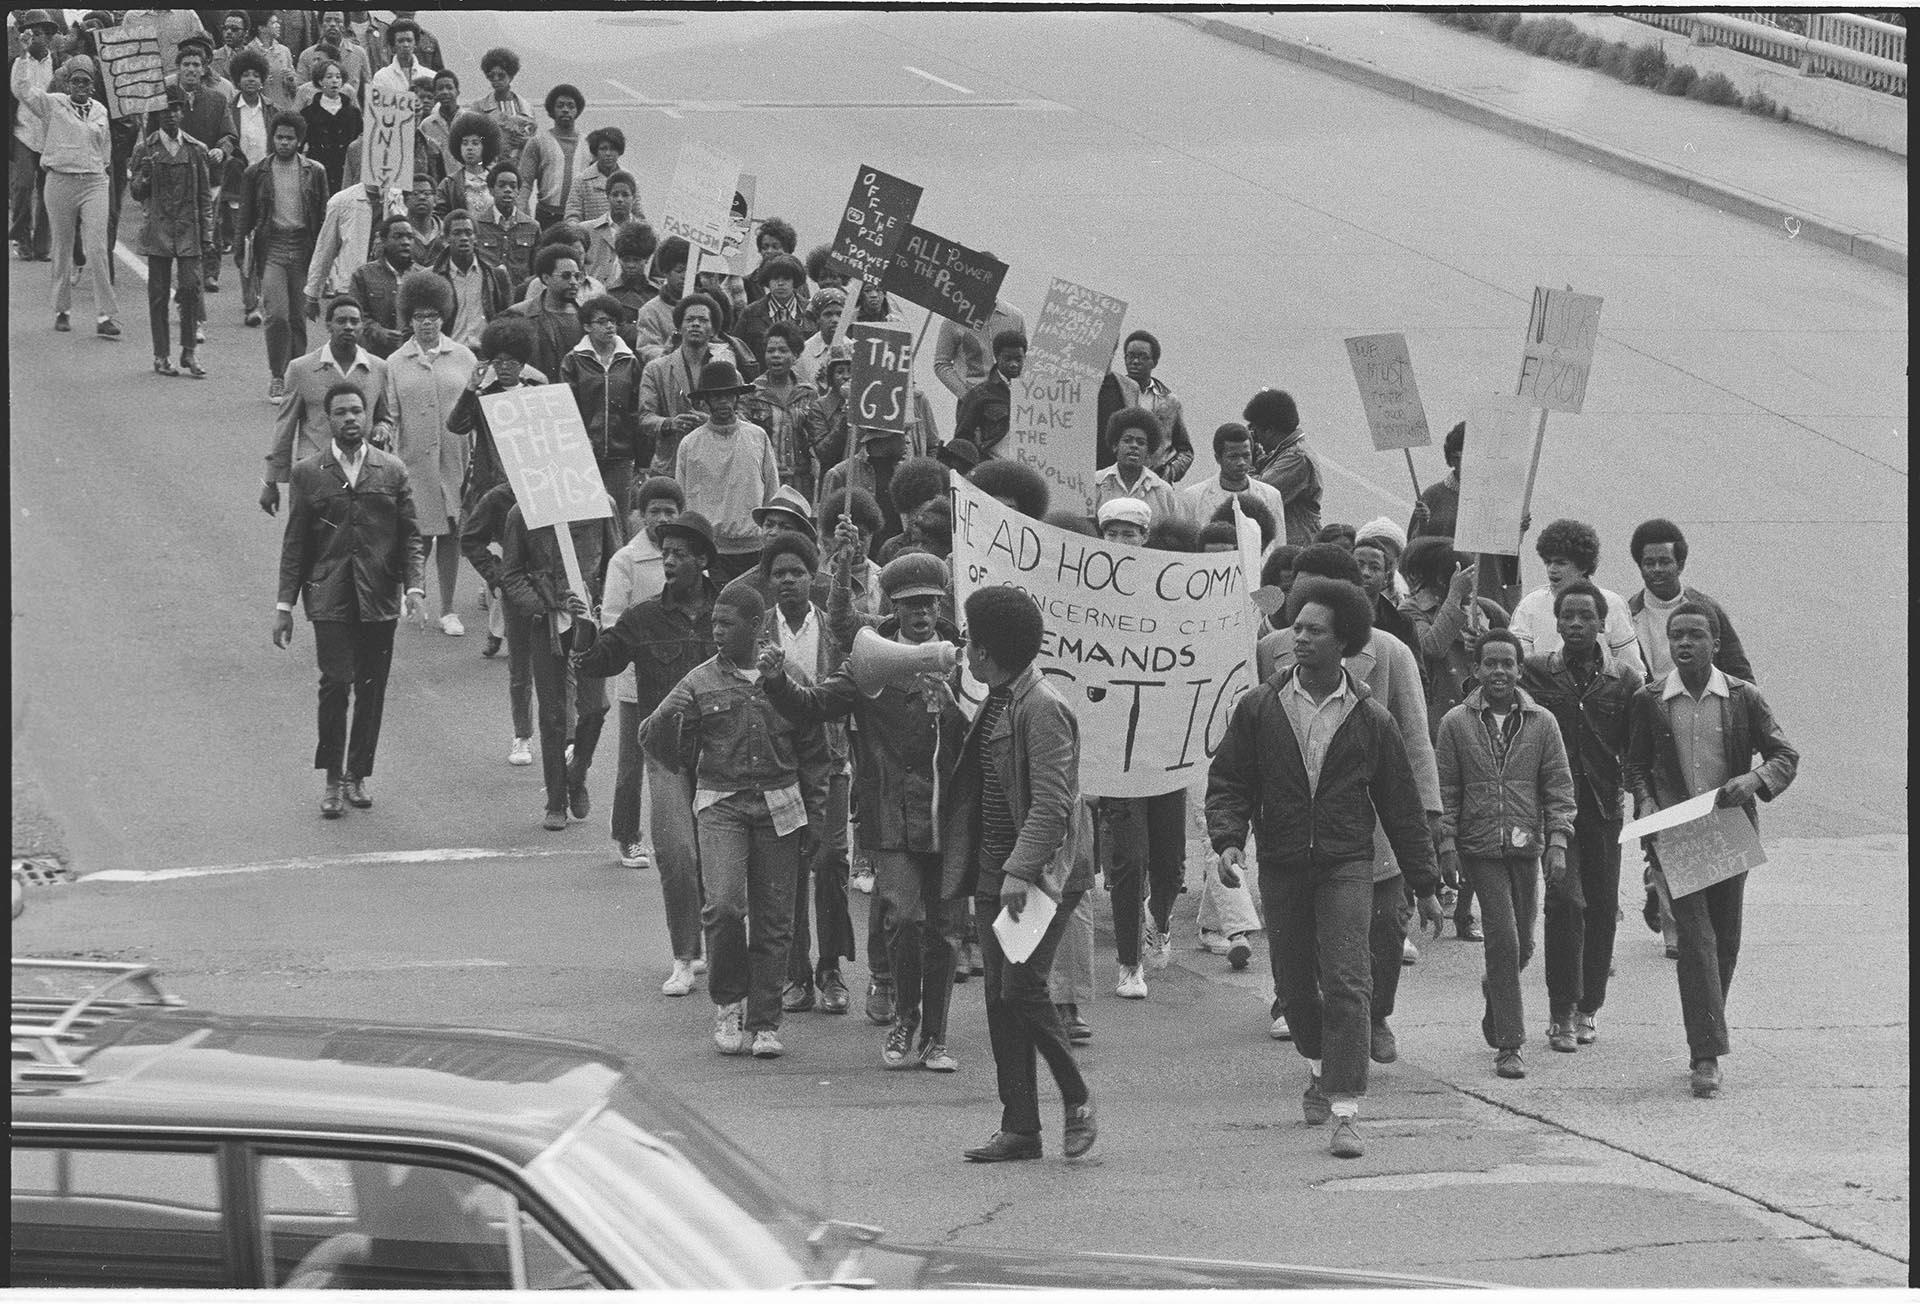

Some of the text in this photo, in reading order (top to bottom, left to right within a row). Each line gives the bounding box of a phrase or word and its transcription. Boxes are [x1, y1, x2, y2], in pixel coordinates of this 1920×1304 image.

[372, 88, 415, 112] BLACK
[378, 114, 396, 189] UNITY
[863, 173, 881, 209] OFF
[858, 226, 884, 246] PIG
[907, 236, 993, 283] ALL POWER
[914, 260, 937, 278] THE
[934, 268, 985, 331] PEOPLE
[494, 390, 563, 426] OFF
[860, 380, 904, 421] GS
[1021, 379, 1081, 404] YOUTH
[1016, 403, 1075, 429] MAKE
[495, 418, 591, 463] THE
[1016, 430, 1048, 445] THE
[520, 463, 602, 515] PIGS
[949, 486, 979, 549] THE
[987, 519, 1042, 572] AD
[1057, 542, 1137, 596] HOC
[968, 564, 989, 585] OF
[1003, 580, 1157, 633] NCERNED
[1040, 630, 1196, 673] EMANDS
